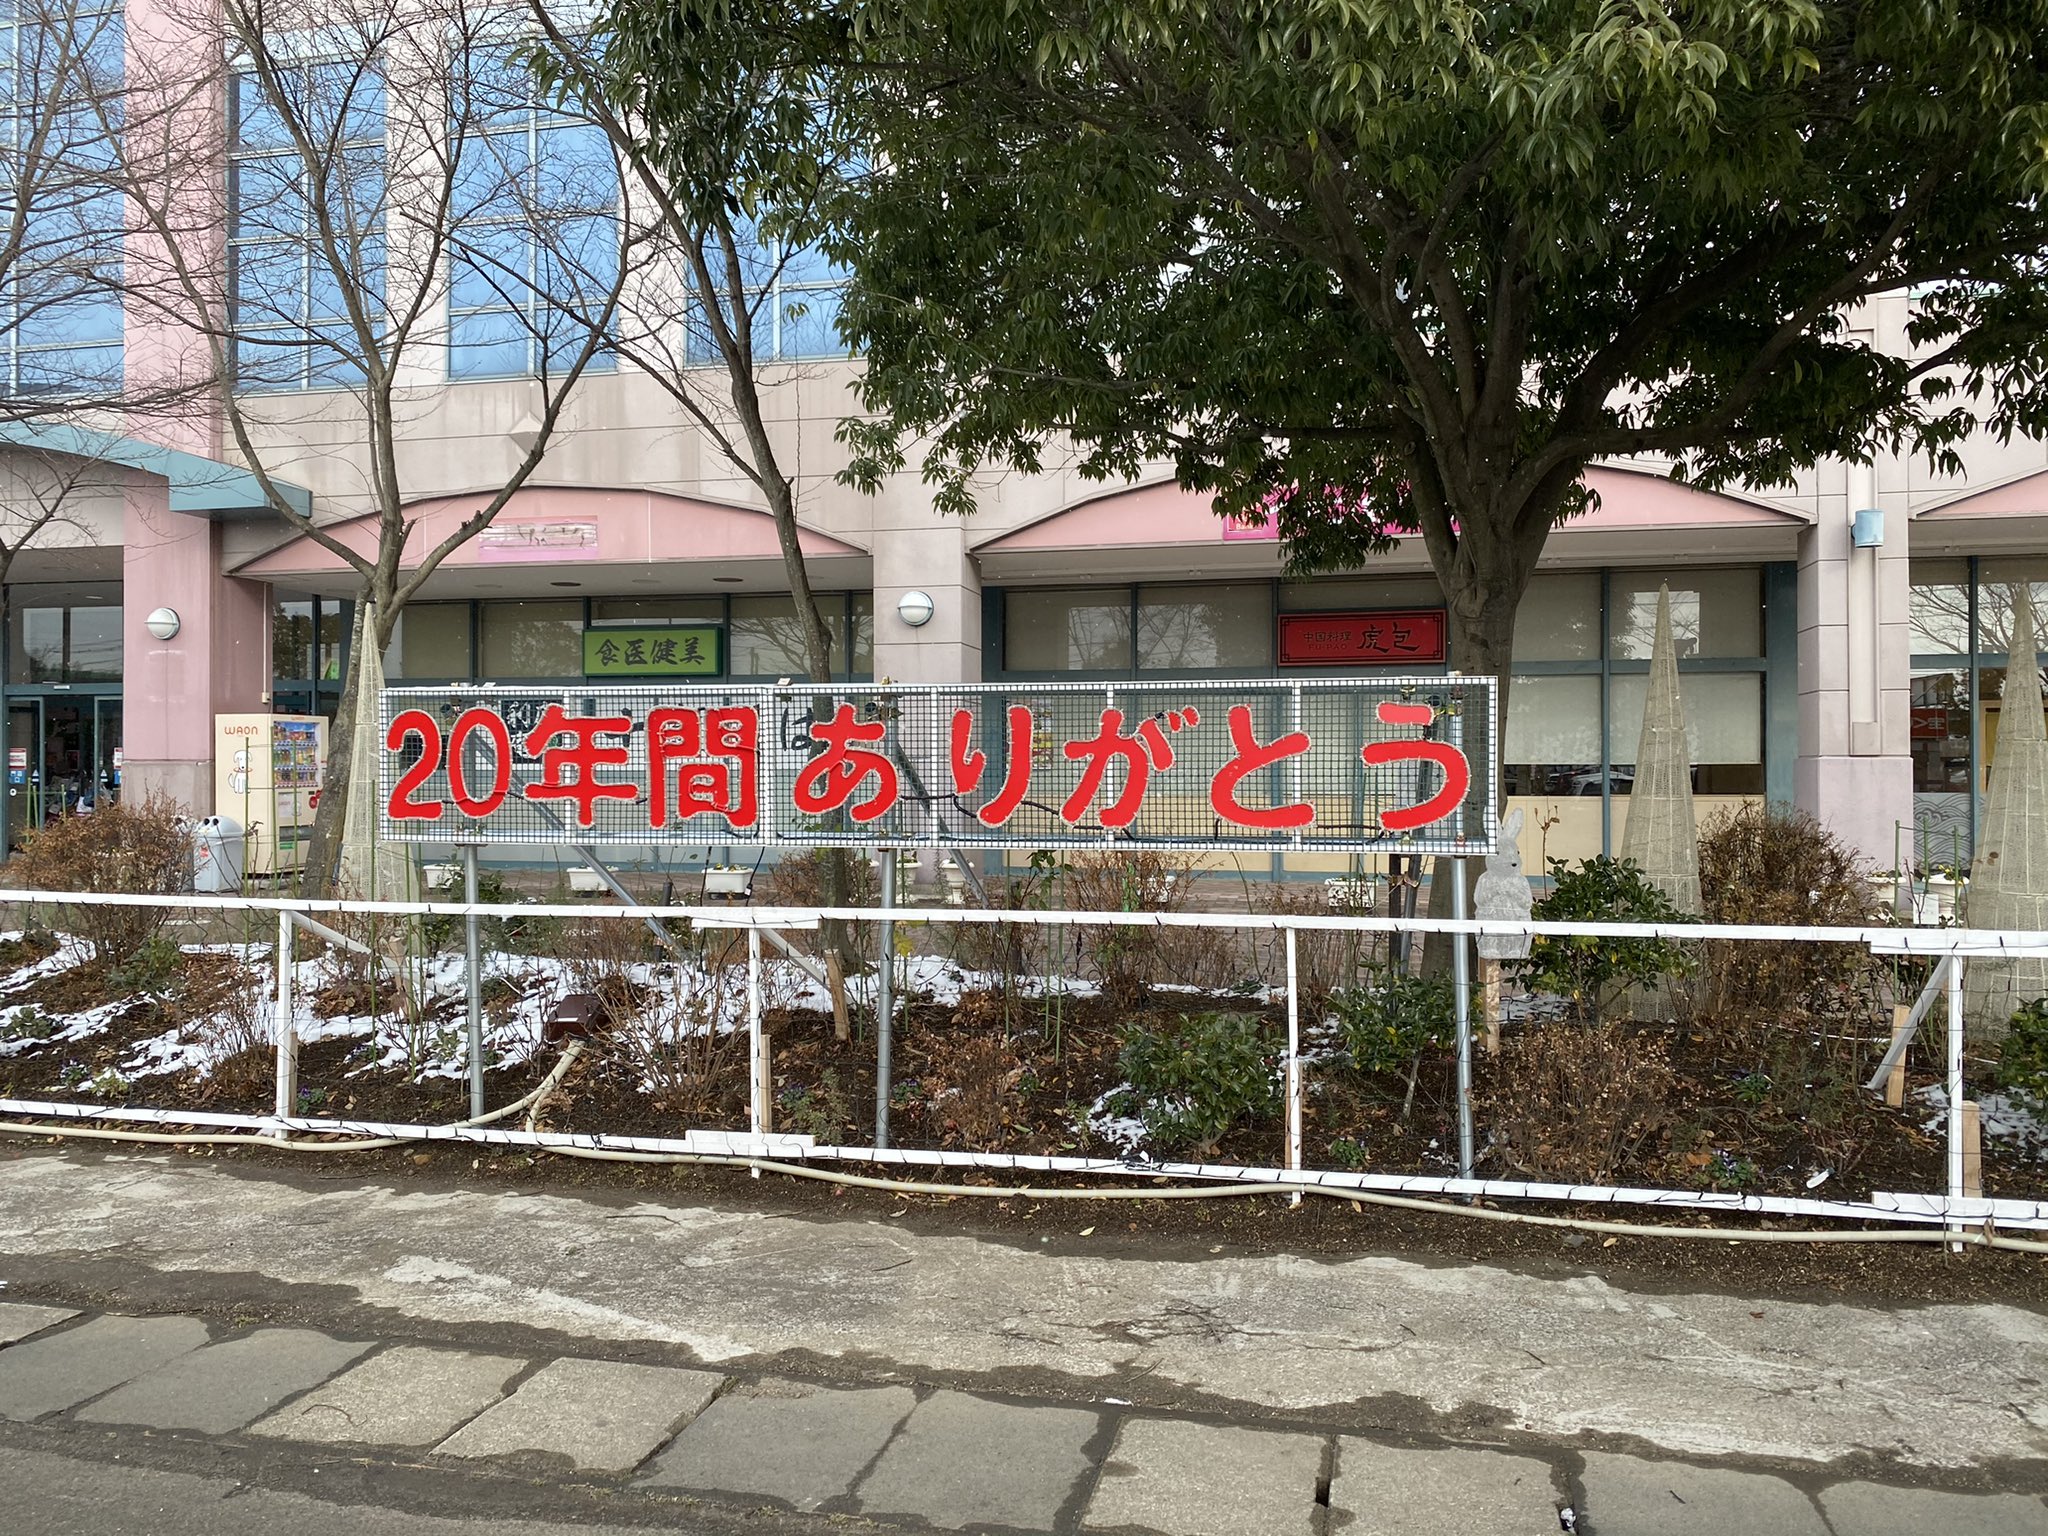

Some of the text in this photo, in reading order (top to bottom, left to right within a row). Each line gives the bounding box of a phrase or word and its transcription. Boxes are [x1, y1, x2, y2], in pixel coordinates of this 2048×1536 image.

[1304, 631, 1352, 642] 中国料理
[595, 637, 705, 666] 食医健美
[224, 726, 258, 735] WAON
[386, 703, 1469, 831] 20年間ありがとう
